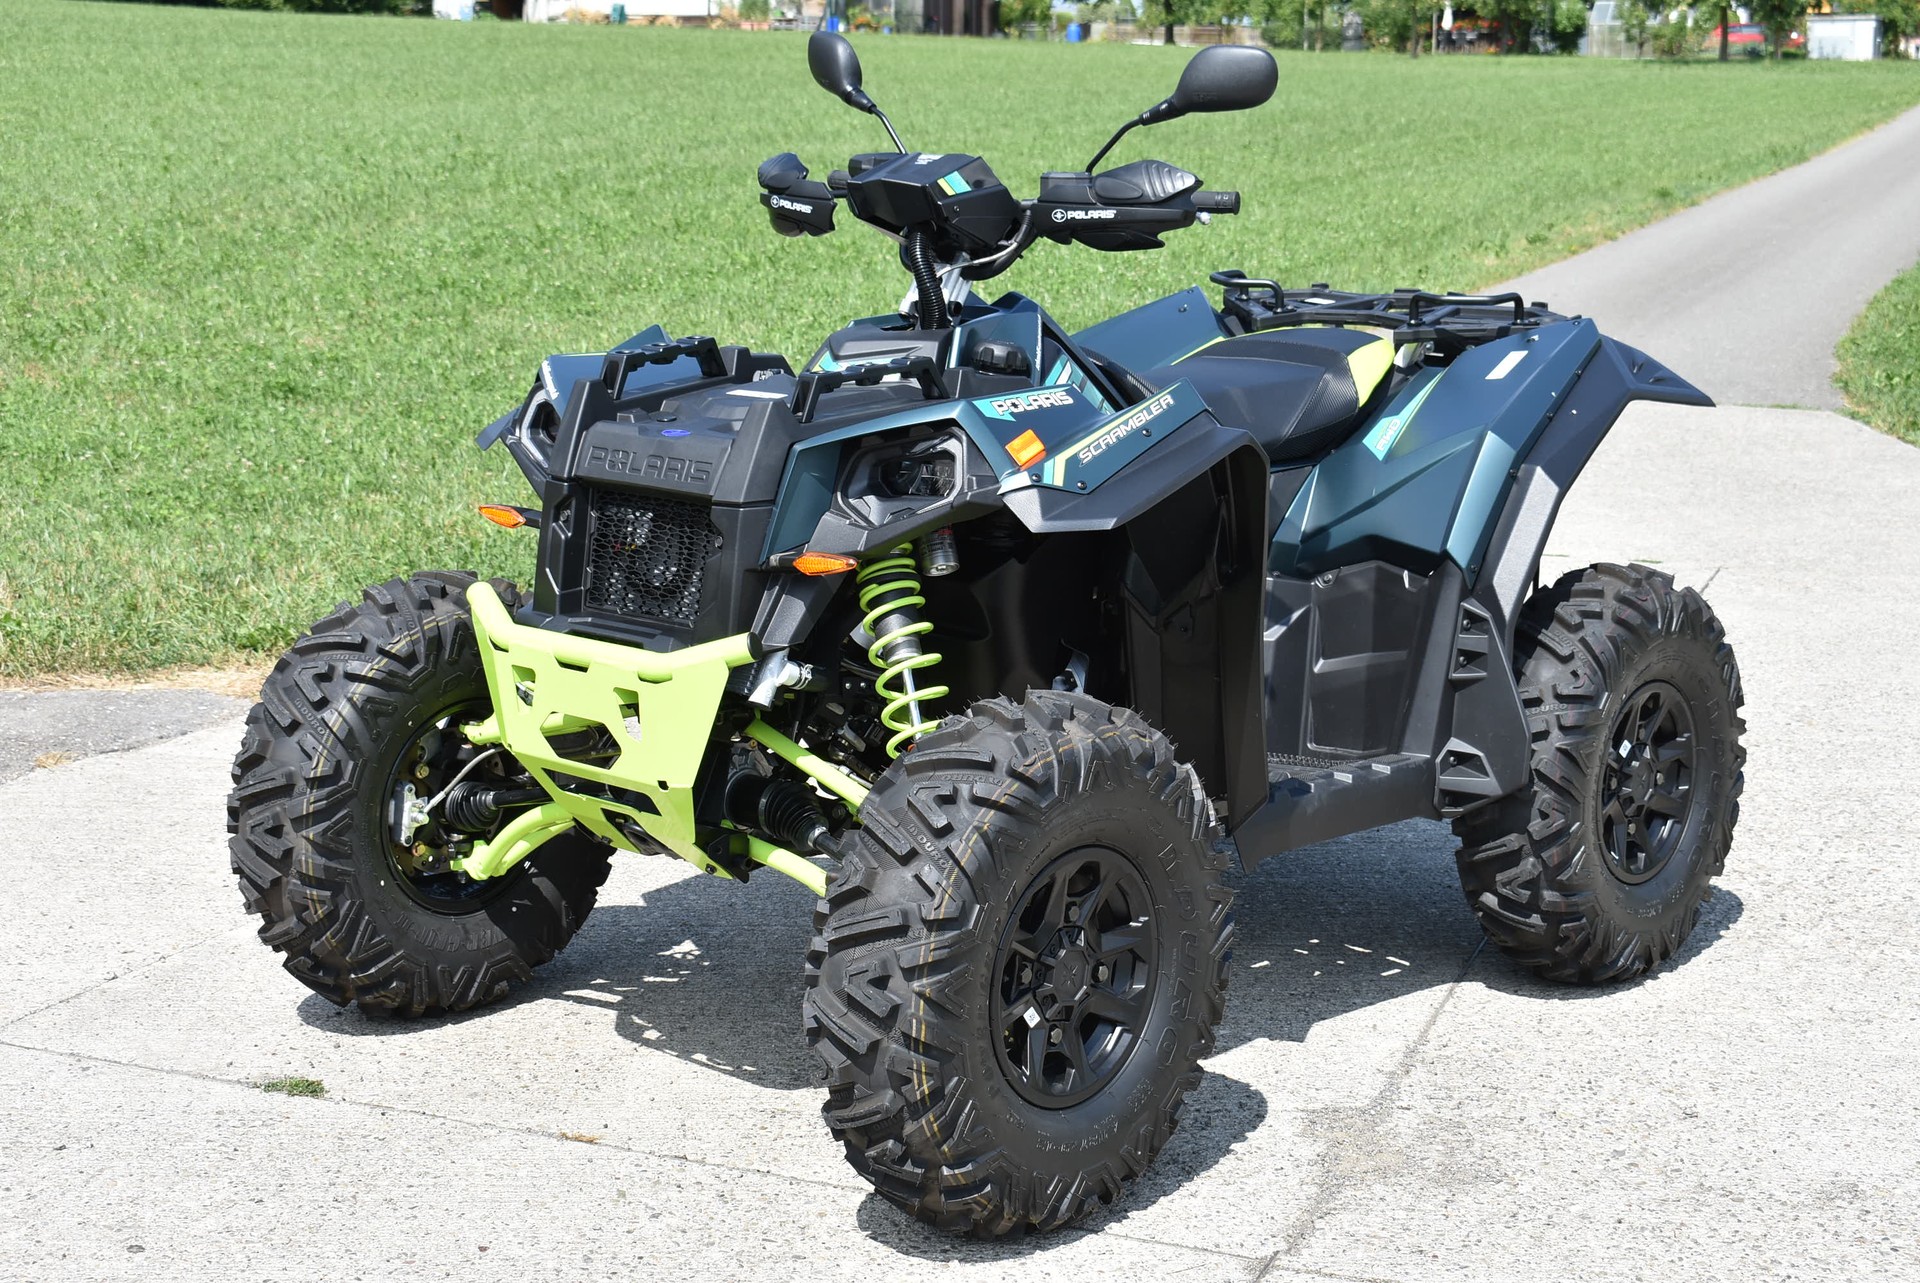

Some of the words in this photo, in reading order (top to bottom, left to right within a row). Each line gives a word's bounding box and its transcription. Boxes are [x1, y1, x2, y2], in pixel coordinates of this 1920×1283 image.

[780, 199, 813, 214] POLARIS
[1067, 209, 1117, 220] POLARIS
[990, 391, 1074, 416] POLARIS
[1079, 394, 1175, 465] SCRAMBLER
[585, 445, 714, 484] POLARIS
[916, 834, 947, 868] DURO
